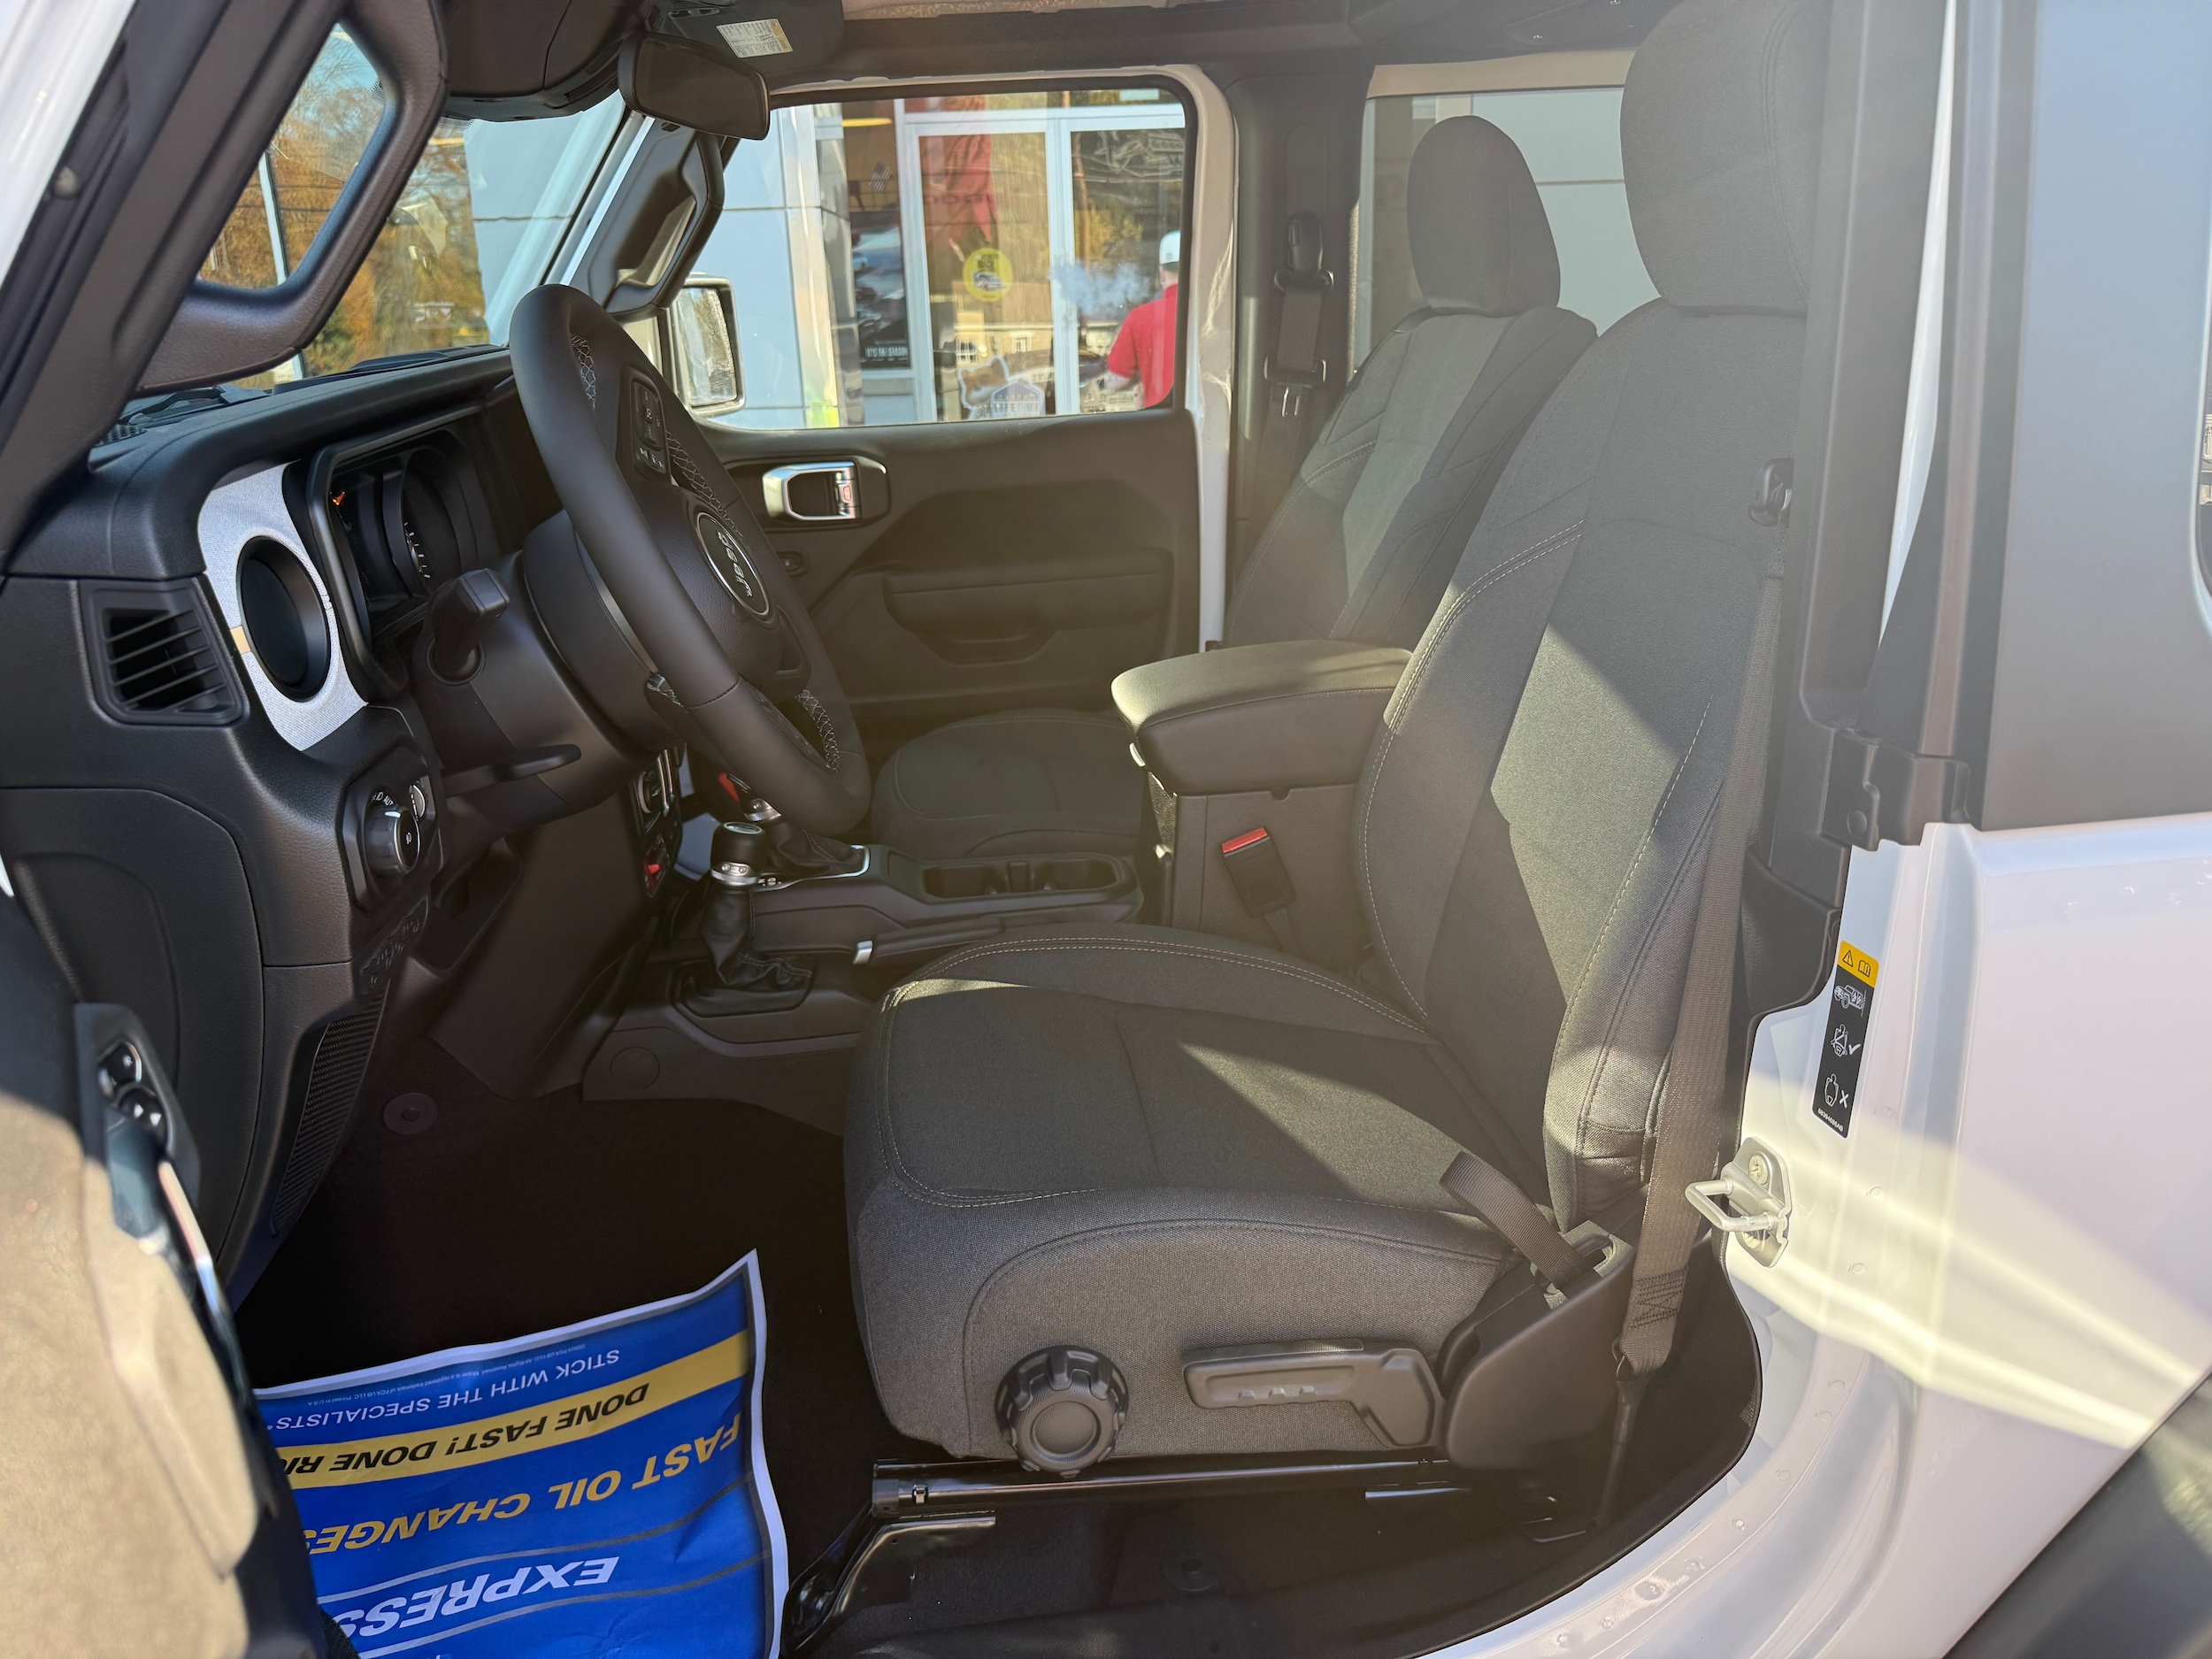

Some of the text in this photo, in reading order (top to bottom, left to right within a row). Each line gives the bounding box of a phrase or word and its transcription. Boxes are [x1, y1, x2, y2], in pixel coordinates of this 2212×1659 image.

[717, 530, 753, 597] Jeep
[490, 1370, 549, 1398] WITH
[556, 1349, 620, 1379] STICK
[437, 1387, 483, 1409] THE
[283, 1382, 649, 1476] DONE FAST! DONE RI
[631, 1411, 741, 1490] FAST
[548, 1469, 622, 1510] OIL
